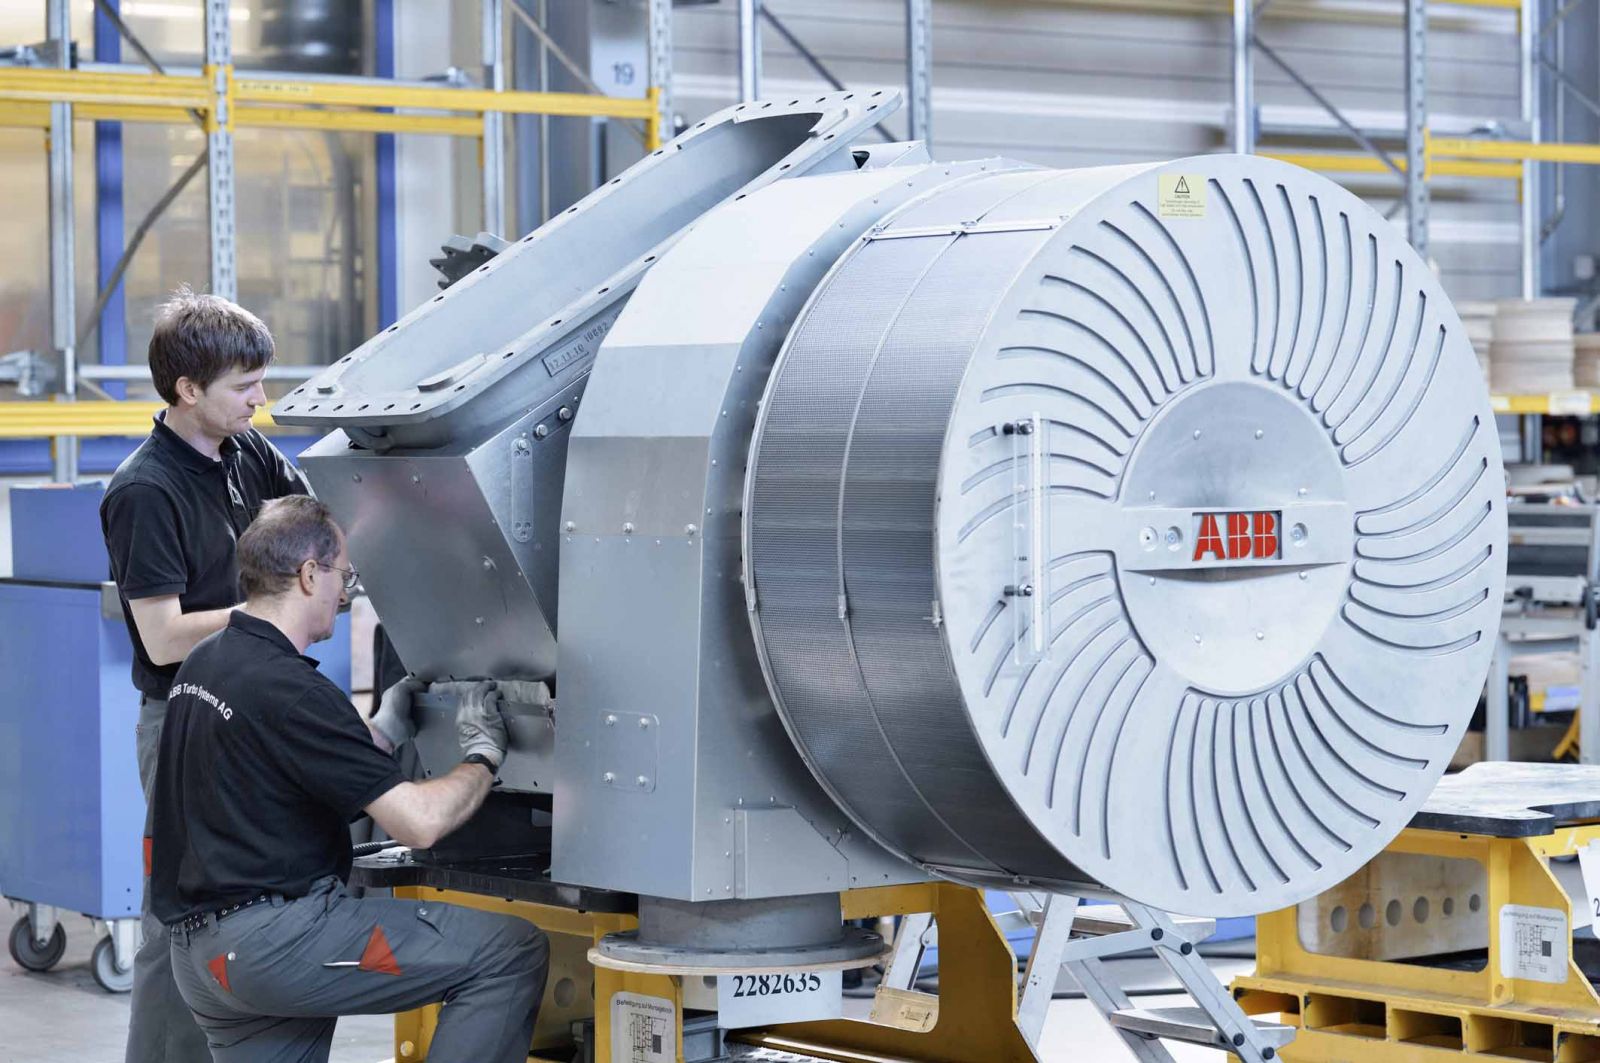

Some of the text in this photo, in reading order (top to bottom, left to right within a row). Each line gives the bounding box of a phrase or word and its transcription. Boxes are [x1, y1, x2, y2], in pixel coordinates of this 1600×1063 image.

[612, 62, 635, 85] 19
[1193, 512, 1277, 560] ABB
[183, 683, 199, 695] Turbo
[198, 685, 219, 708] Systems
[218, 701, 233, 721] AG
[733, 972, 821, 998] 2282635
